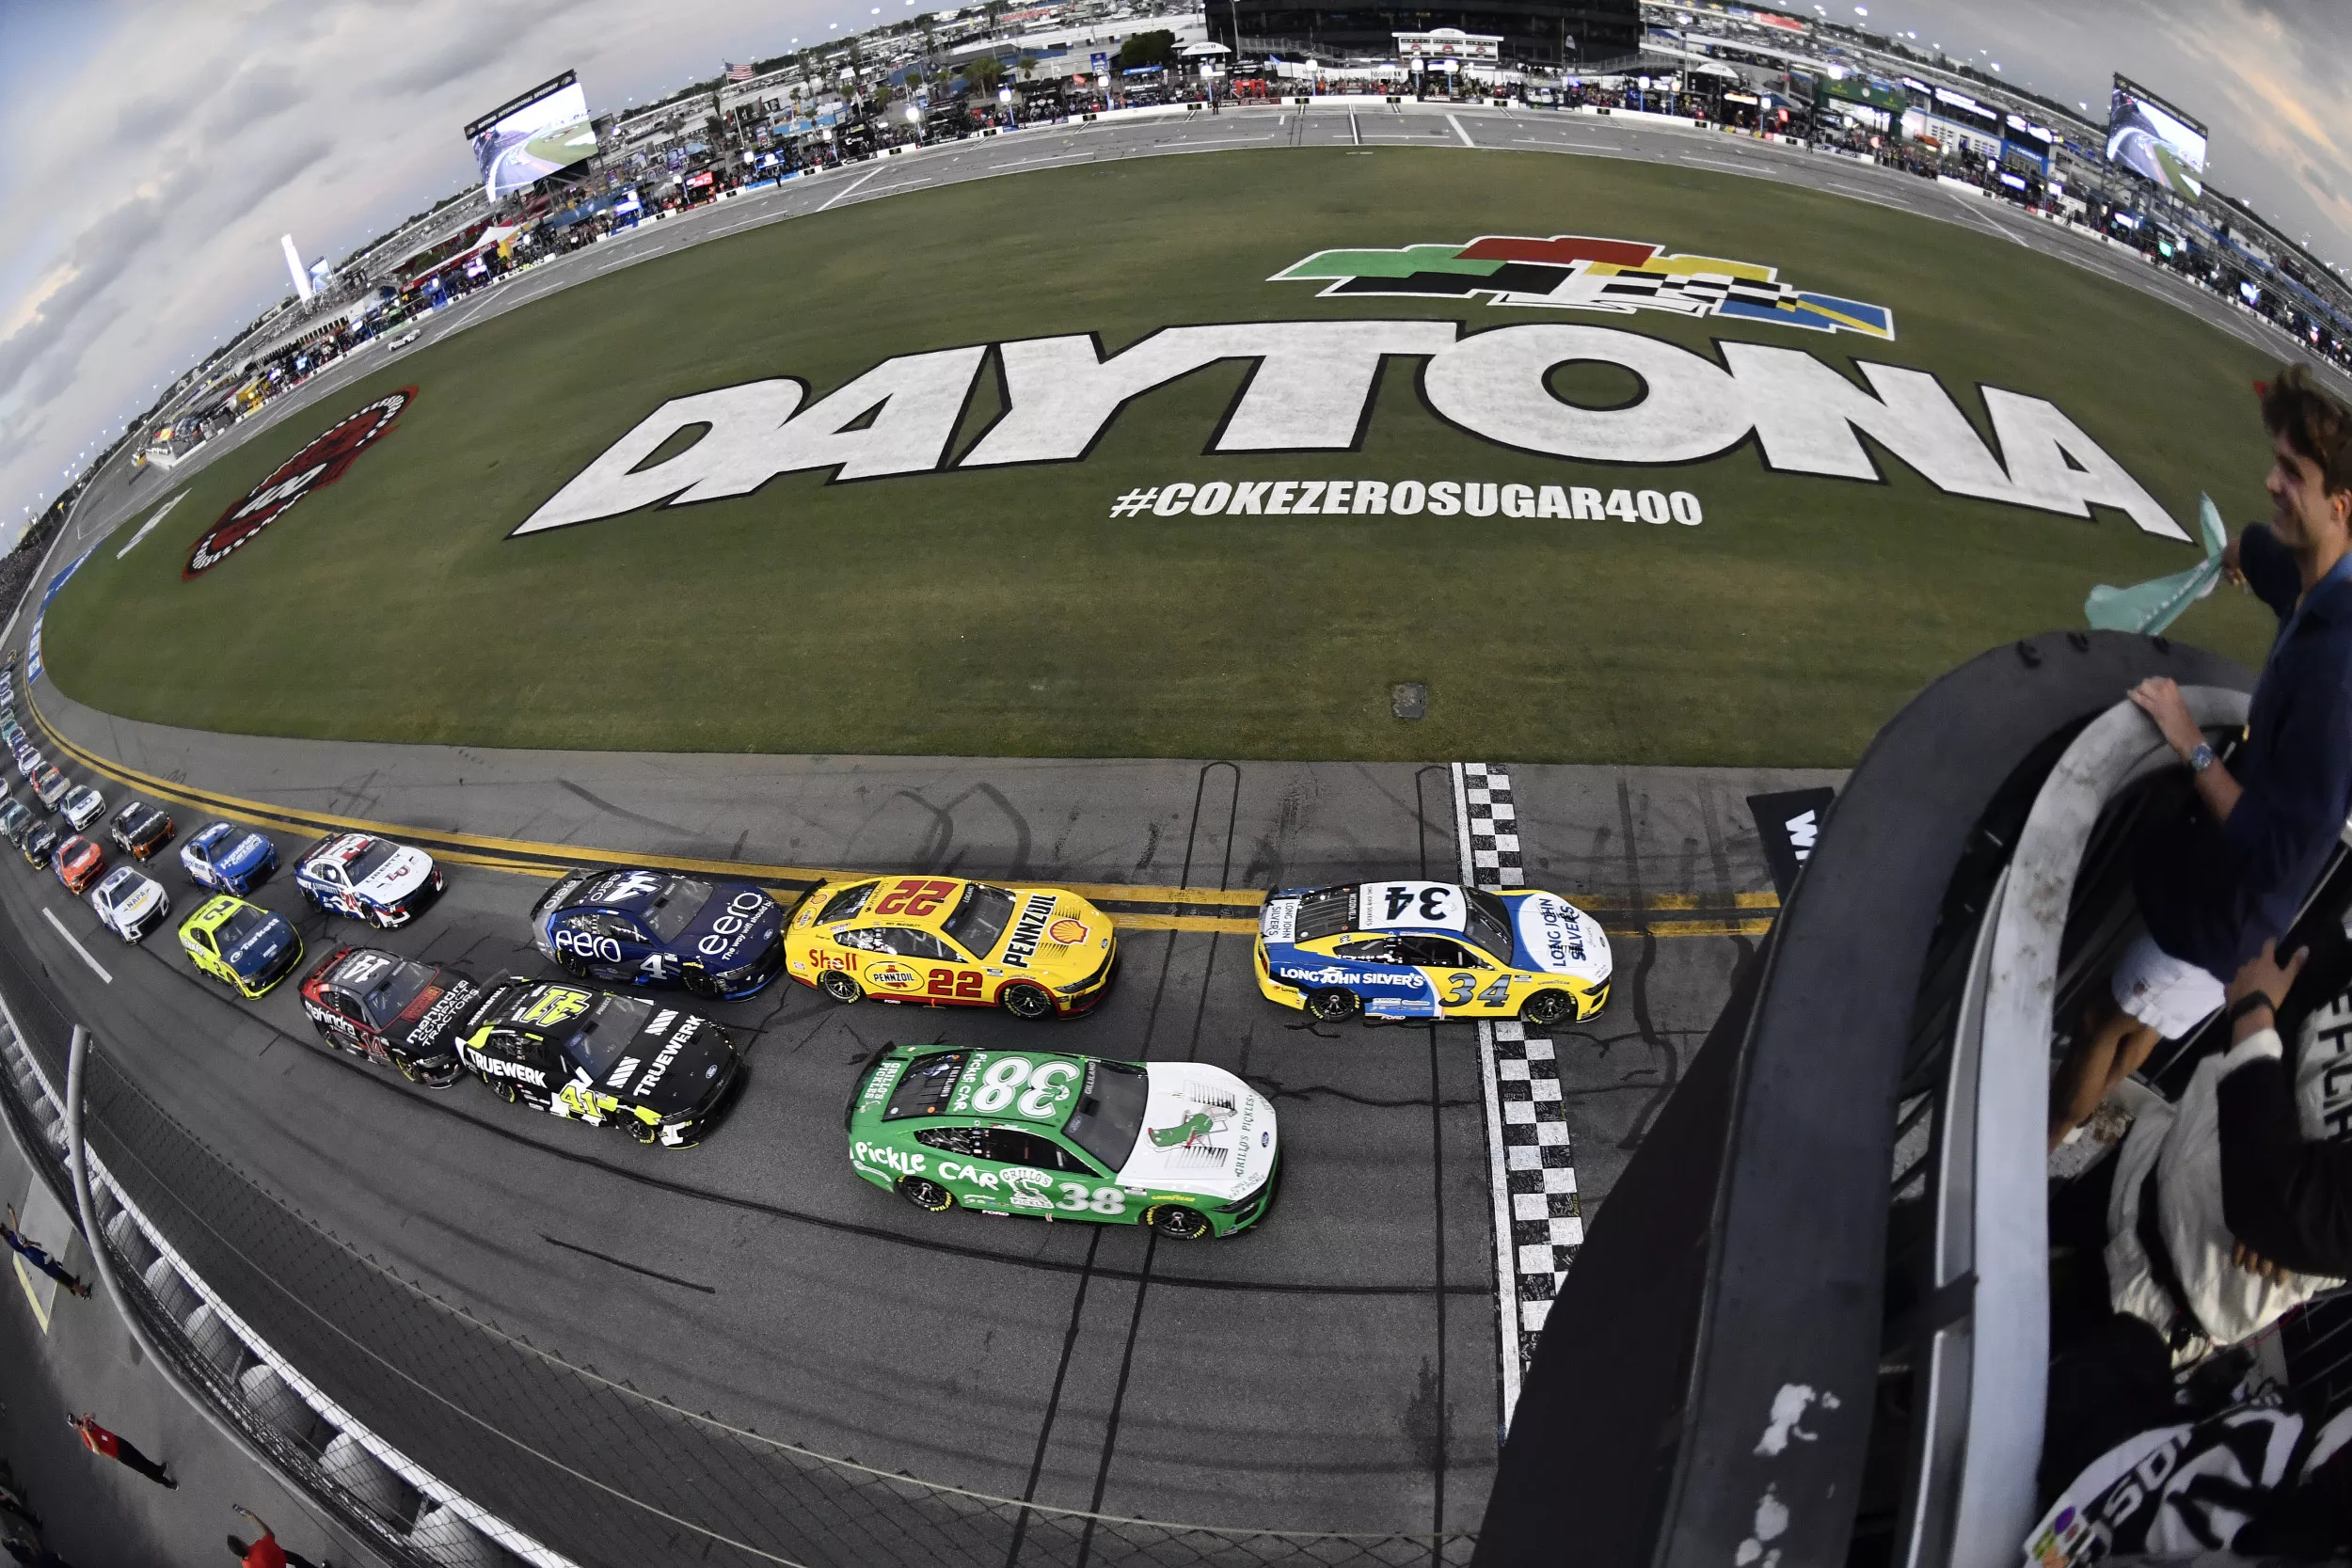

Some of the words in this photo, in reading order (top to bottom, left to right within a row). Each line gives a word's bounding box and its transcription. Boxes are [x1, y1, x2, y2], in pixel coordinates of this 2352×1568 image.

[499, 95, 533, 118] INTERNATIONAL
[534, 83, 559, 99] SPEEDWAY
[508, 320, 2195, 543] DAYTONA
[1108, 480, 1704, 526] #COKEZEROSUGAR400
[365, 852, 401, 883] LIBERTY
[126, 891, 148, 909] NAPA
[875, 879, 960, 917] 22
[1285, 902, 1295, 919] LONG
[1385, 886, 1450, 921] 34
[1539, 898, 1557, 927] JOHN
[698, 892, 763, 955] eero
[722, 947, 736, 960] The
[732, 934, 746, 947] way
[751, 906, 768, 924] should
[1002, 894, 1057, 968] PENNZOIL
[1269, 906, 1281, 936] SILVER'S
[1282, 921, 1292, 939] JOHN
[1560, 906, 1586, 961] SILVER'S
[555, 929, 622, 963] eero
[809, 948, 857, 972] Shell
[1548, 929, 1566, 967] LONG
[342, 955, 390, 983] 14
[640, 952, 668, 980] 4
[873, 973, 915, 982] PENNZOIL
[1280, 967, 1319, 982] LONG
[1319, 970, 1360, 984] JOHN
[1362, 973, 1424, 989] SILVER'S
[928, 968, 983, 999] 22
[1438, 973, 1512, 1007] 34
[305, 1000, 356, 1036] mahindra
[406, 979, 469, 1044] mahindra
[419, 987, 469, 1041] COMPACT
[422, 989, 480, 1046] TRACTORS
[468, 987, 507, 1026] TRUEWERK
[519, 986, 592, 1027] 41
[361, 1032, 390, 1061] 14
[633, 1015, 707, 1097] TRUEWERK
[468, 1048, 548, 1088] TRUEWERK
[865, 1063, 887, 1099] PICKLES
[875, 1062, 901, 1105] GRILLO'S
[1084, 1062, 1096, 1095] GILLILAND
[559, 1085, 604, 1118] 41
[953, 1085, 971, 1112] CAR
[971, 1056, 1080, 1118] 38
[1242, 1098, 1255, 1132] PICKLES
[1235, 1135, 1250, 1176] GRILLO'S
[938, 1162, 999, 1191] CAR
[1003, 1168, 1050, 1185] GRILLO'S
[1056, 1182, 1126, 1215] 38
